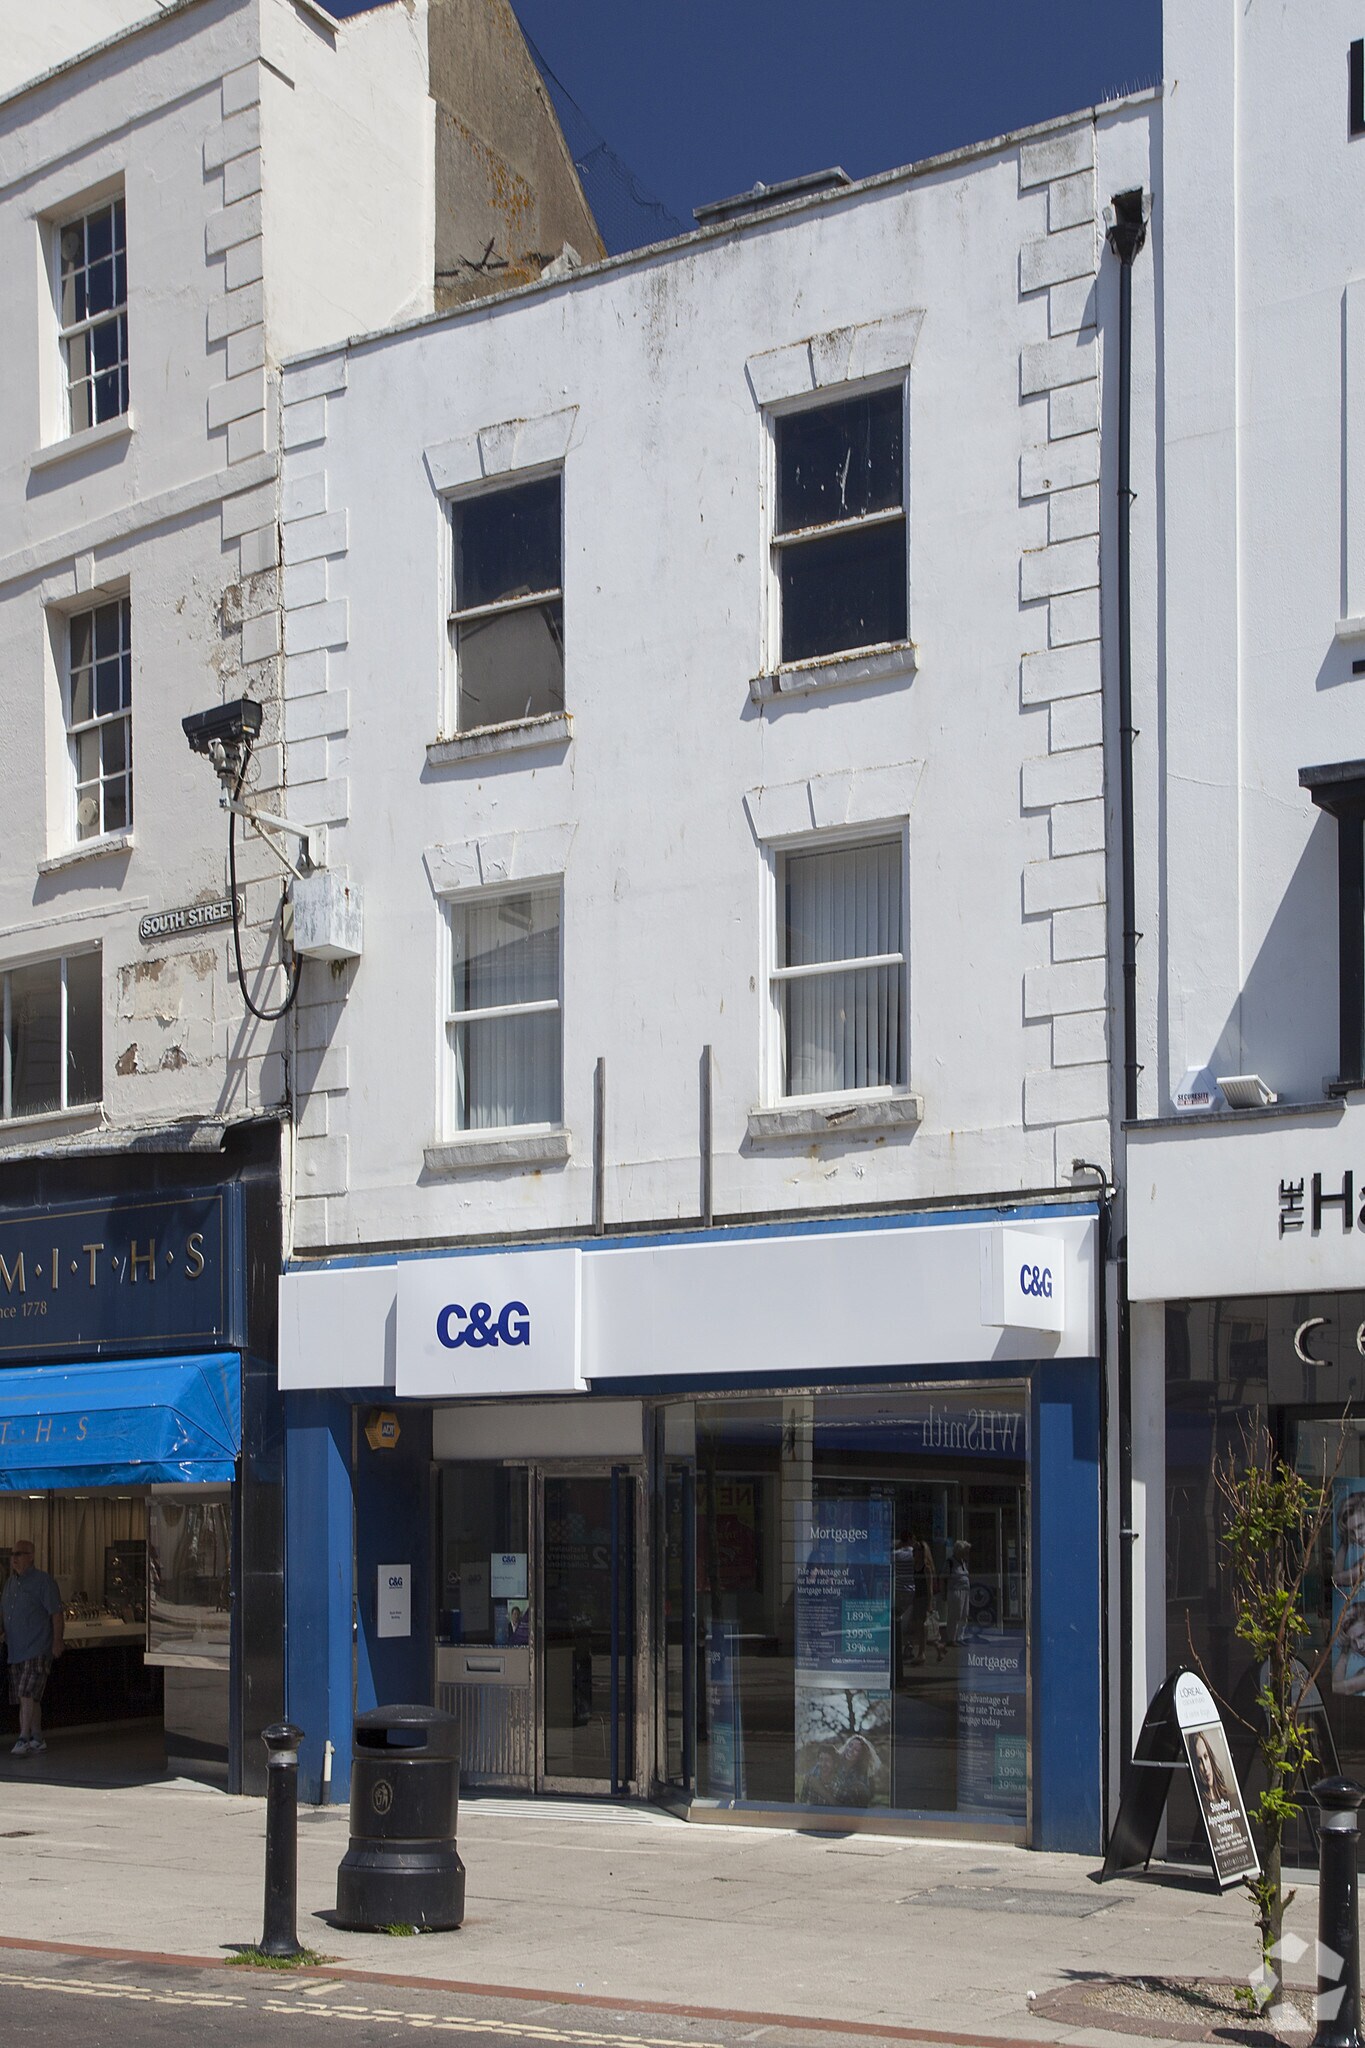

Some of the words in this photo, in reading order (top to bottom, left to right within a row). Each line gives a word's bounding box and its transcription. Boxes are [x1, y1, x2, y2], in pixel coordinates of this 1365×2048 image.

[143, 910, 185, 935] SOUTH
[188, 900, 233, 925] STREET
[1281, 1177, 1304, 1234] THE
[1020, 1264, 1053, 1299] C&G
[21, 1301, 47, 1317] 1778
[437, 1300, 530, 1349] C&G
[382, 1423, 395, 1436] ADT
[810, 1526, 868, 1543] Mortgages
[502, 1555, 516, 1563] C&G
[842, 1567, 849, 1575] of
[389, 1576, 403, 1587] C&G
[829, 1577, 855, 1586] Tracker
[797, 1586, 822, 1597] Mortgage
[846, 1611, 873, 1622] 1.89%
[846, 1629, 873, 1639] 3.99%
[967, 1652, 1018, 1672] Mortgages
[969, 1693, 1001, 1706] advantage
[1002, 1695, 1010, 1705] of
[976, 1706, 988, 1715] rate
[988, 1705, 1016, 1717] Tracker
[999, 1748, 1025, 1759] 1.89%
[998, 1766, 1024, 1777] 3.99%
[1209, 1798, 1231, 1813] Standby
[1207, 1809, 1241, 1828] Appointments
[1218, 1823, 1234, 1835] Today
